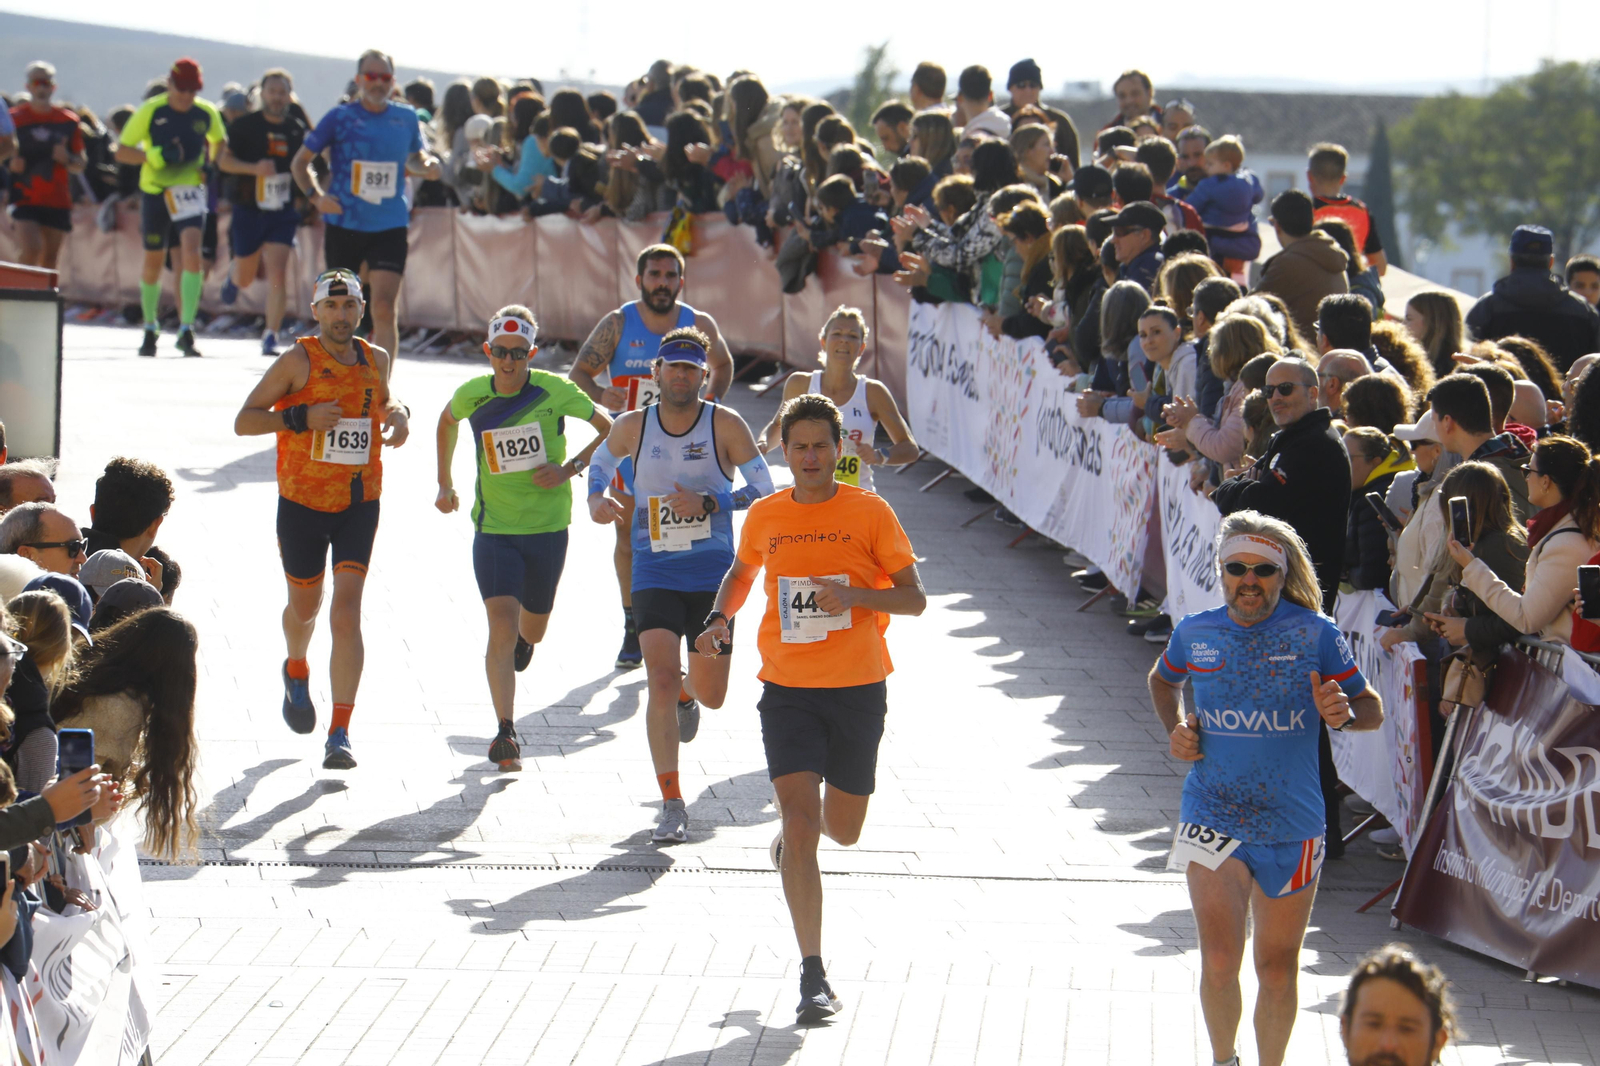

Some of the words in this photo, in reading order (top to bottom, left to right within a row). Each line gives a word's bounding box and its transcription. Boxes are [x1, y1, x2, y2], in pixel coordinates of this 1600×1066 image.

[365, 171, 390, 186] 891
[361, 388, 373, 419] ENA
[642, 390, 661, 406] 21
[327, 429, 369, 450] 1639
[840, 428, 863, 441] ea
[496, 435, 541, 458] 1820
[837, 457, 858, 474] 46
[1191, 642, 1208, 650] Club
[1191, 648, 1219, 657] Maratón
[1268, 654, 1297, 662] enerplus
[1548, 877, 1600, 925] Deport
